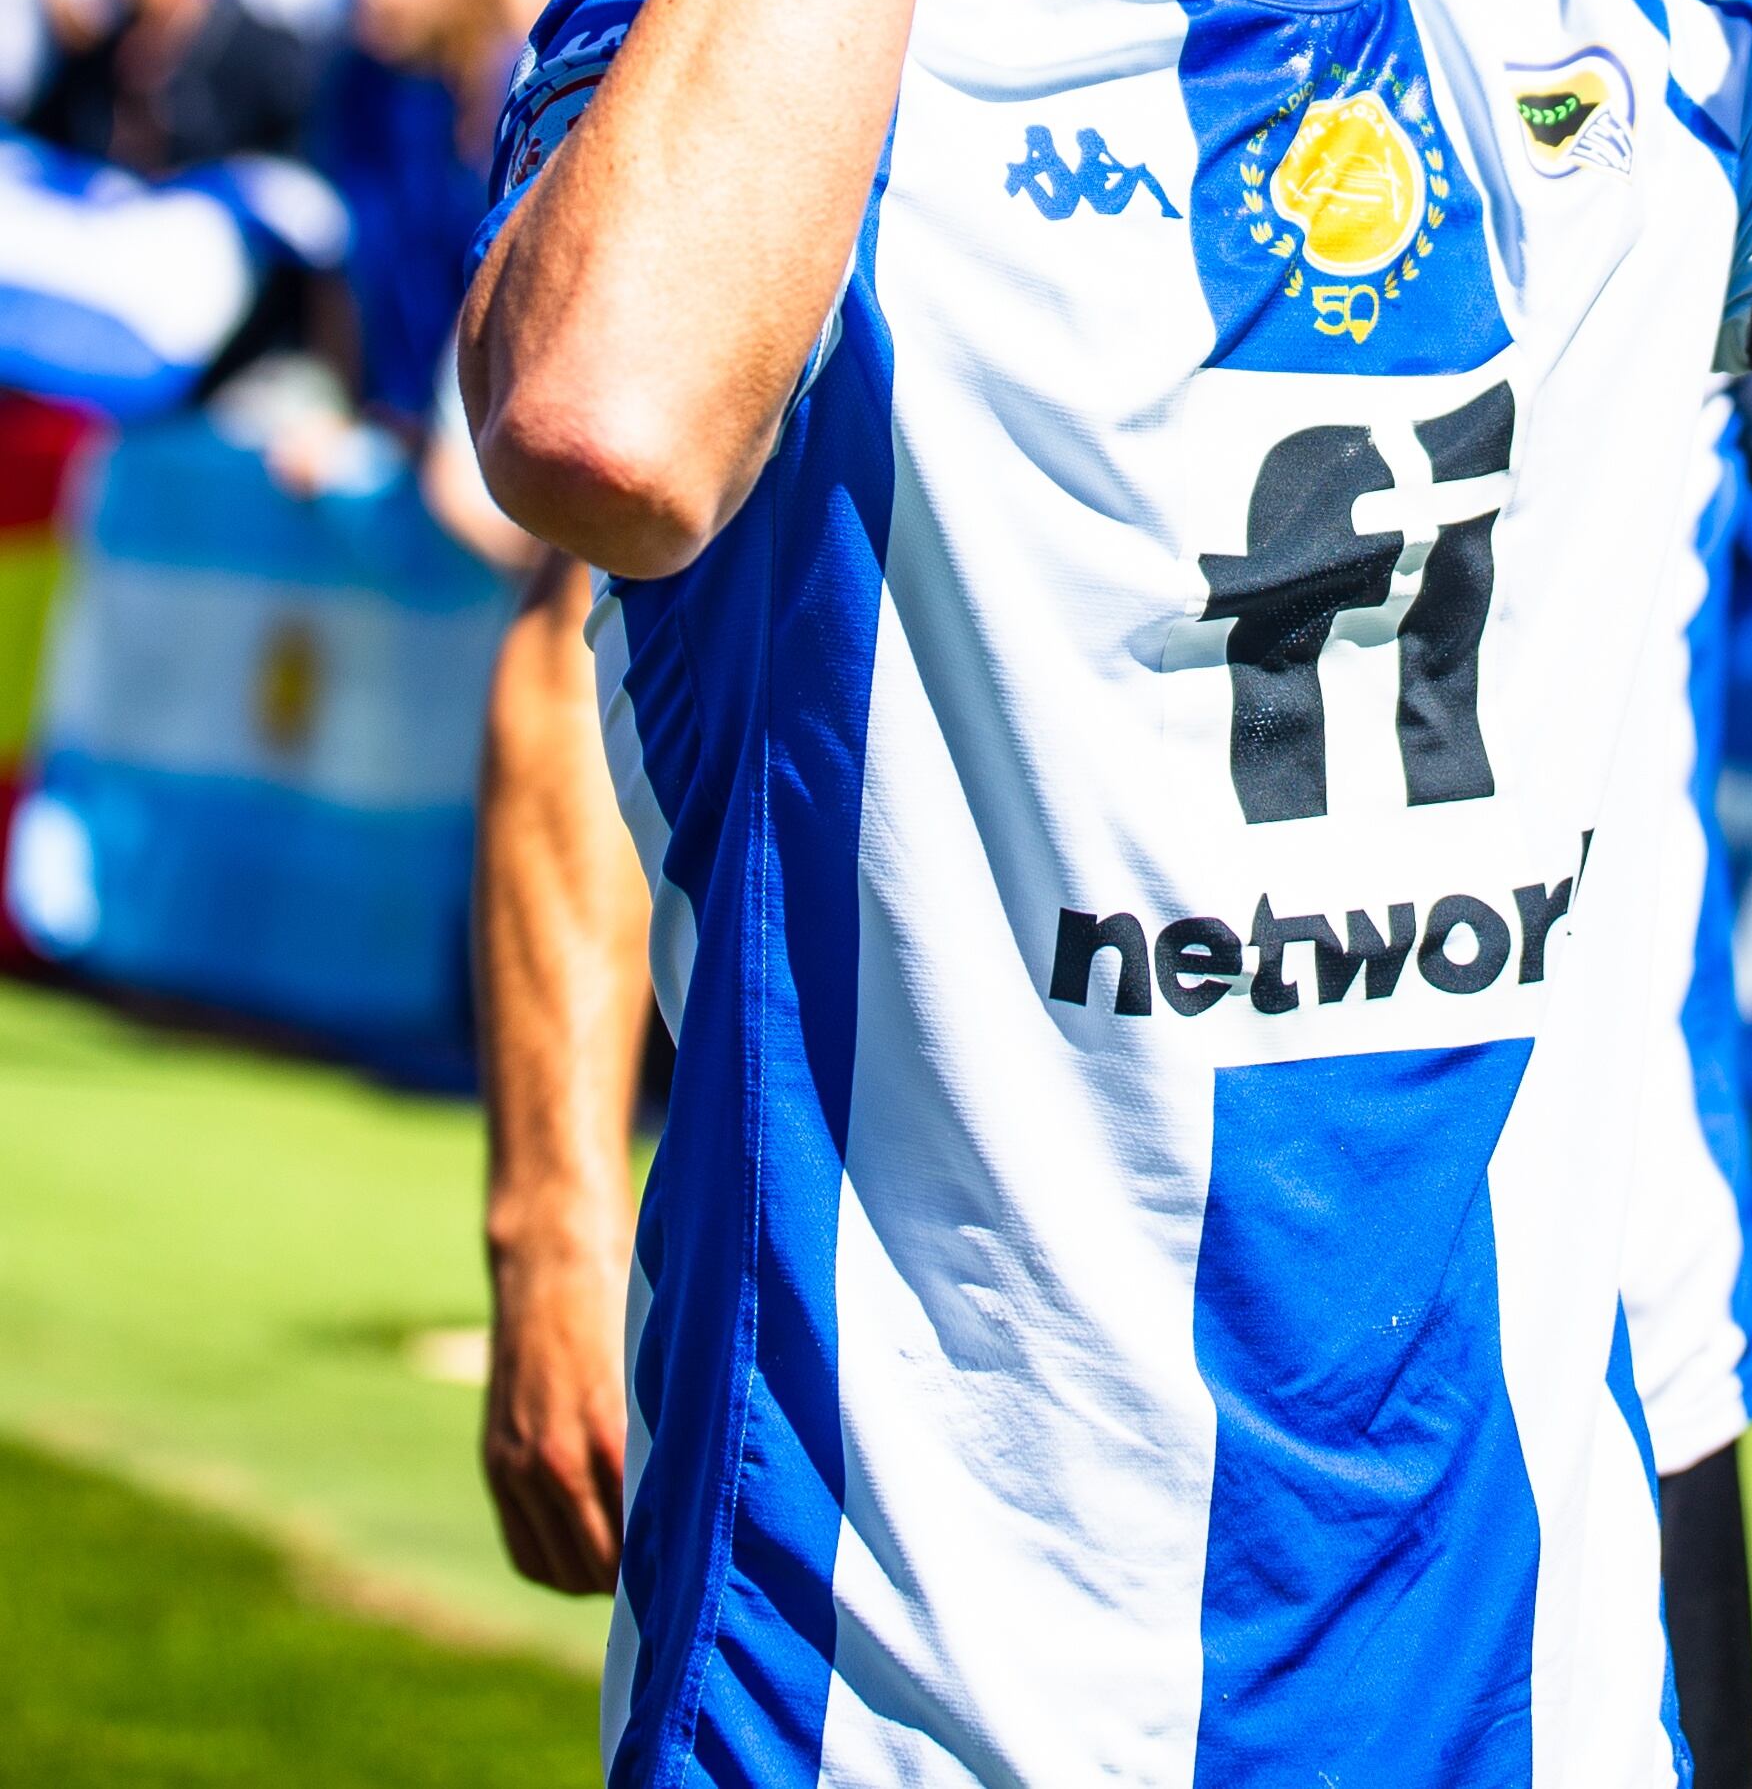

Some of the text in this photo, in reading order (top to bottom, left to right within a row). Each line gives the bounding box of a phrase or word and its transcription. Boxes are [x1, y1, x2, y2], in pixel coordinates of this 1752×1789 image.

[1245, 80, 1316, 156] ESTADIO
[1311, 284, 1379, 344] 50
[1195, 379, 1516, 825] fi
[1048, 827, 1595, 1017] networ
